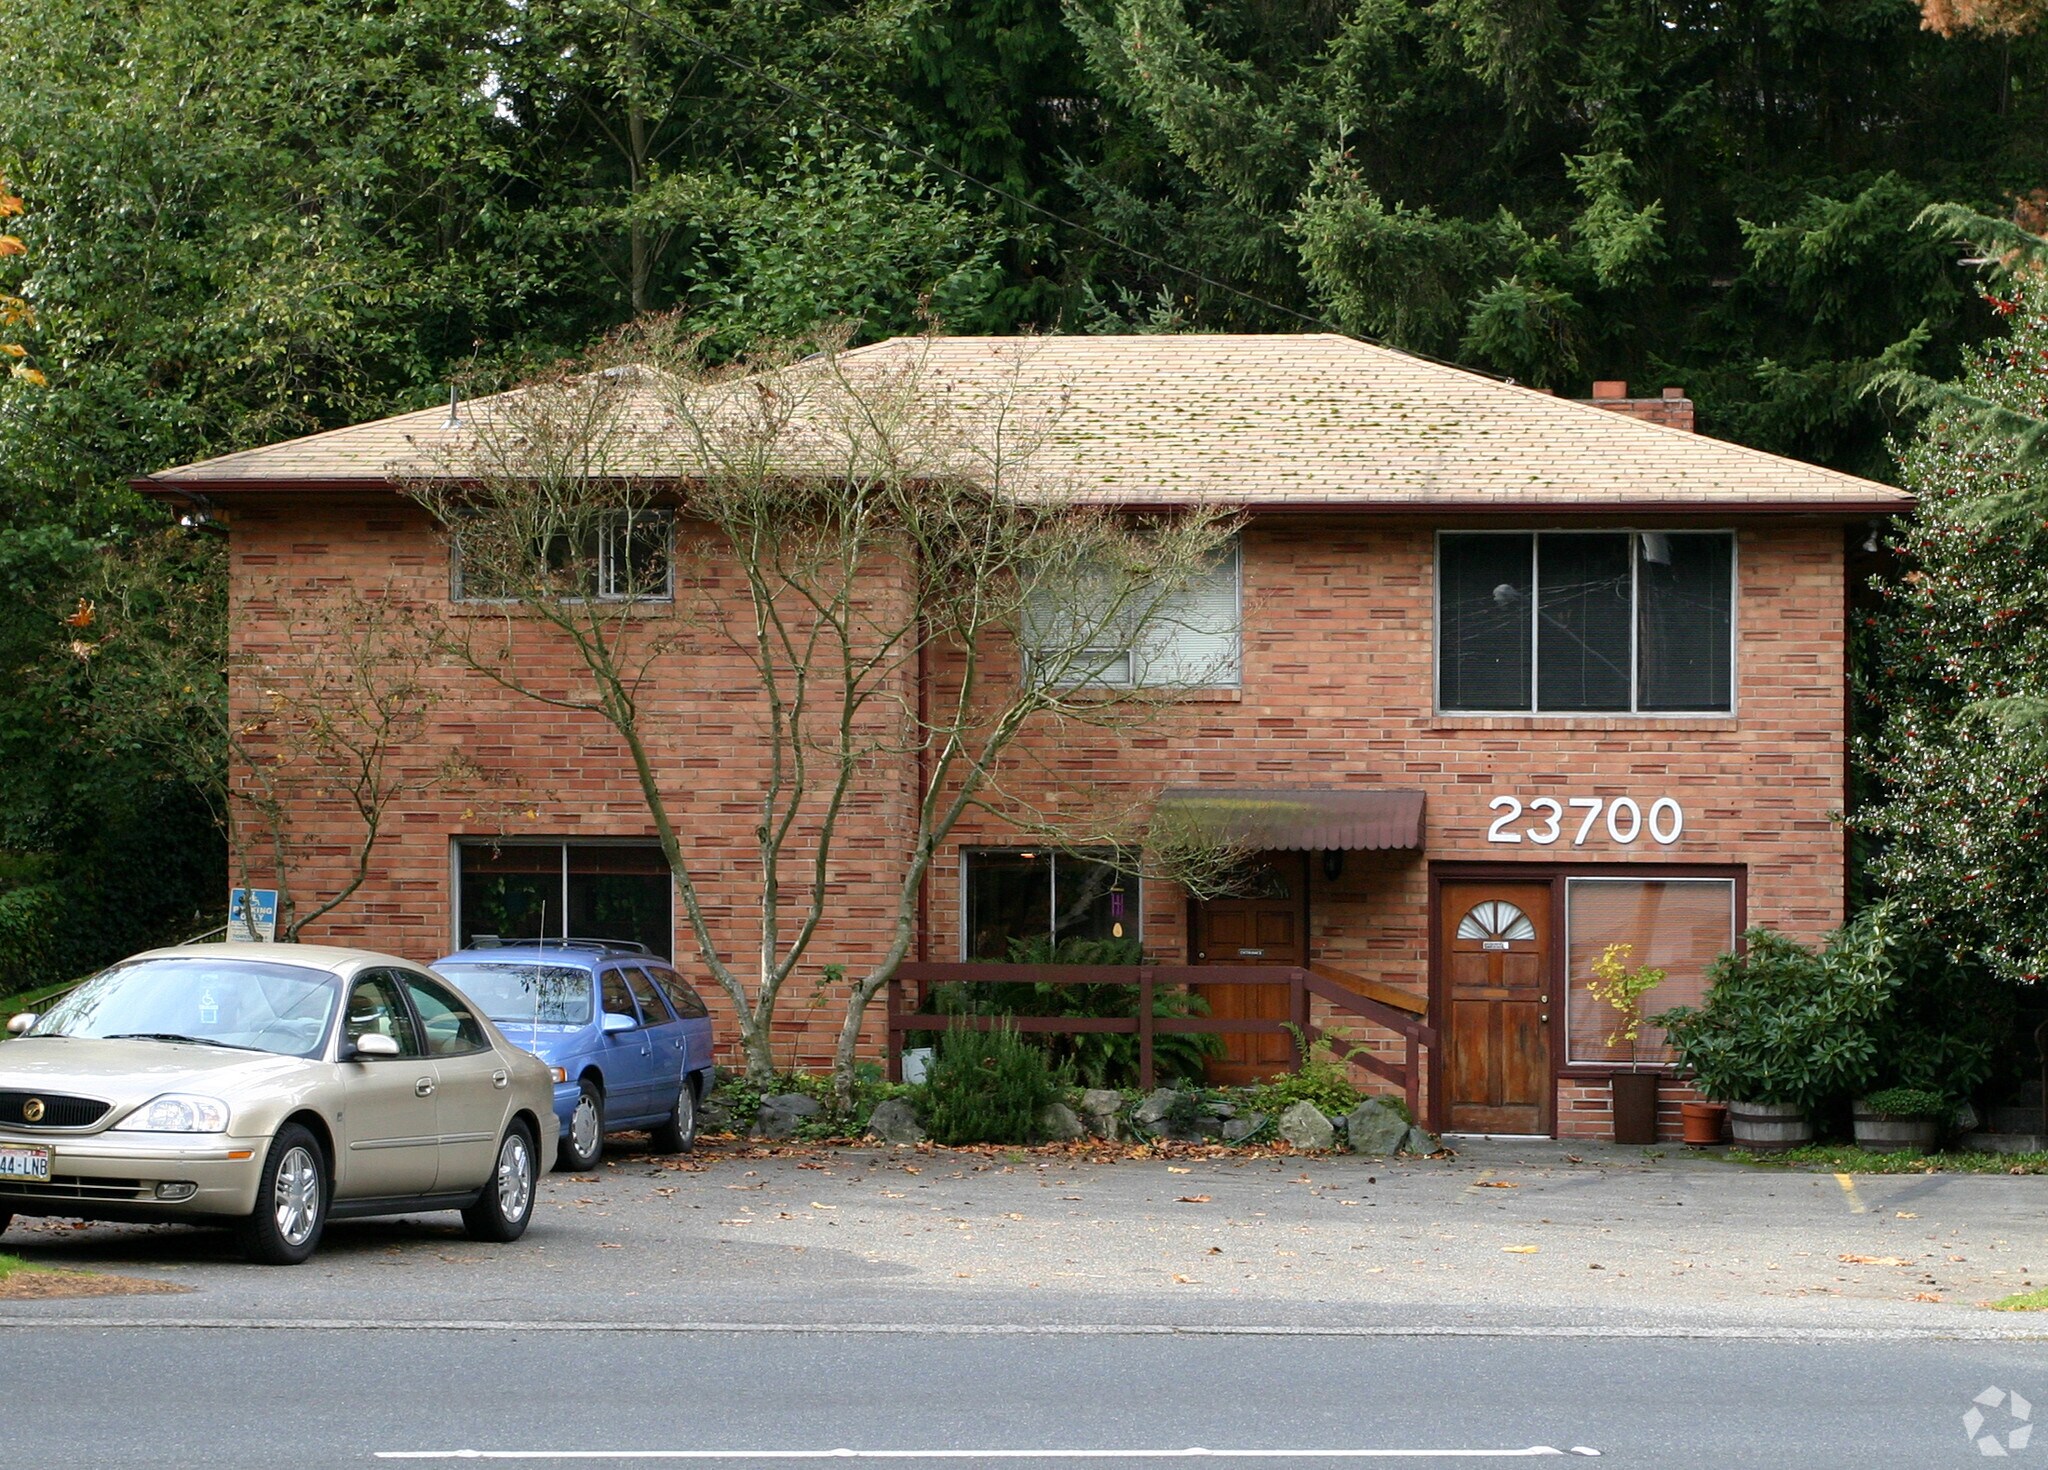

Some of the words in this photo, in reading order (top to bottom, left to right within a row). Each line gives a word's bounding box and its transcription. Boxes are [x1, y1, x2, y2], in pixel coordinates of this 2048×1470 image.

[1487, 795, 1683, 845] 23700
[233, 906, 273, 915] PKING
[240, 912, 265, 921] OLY
